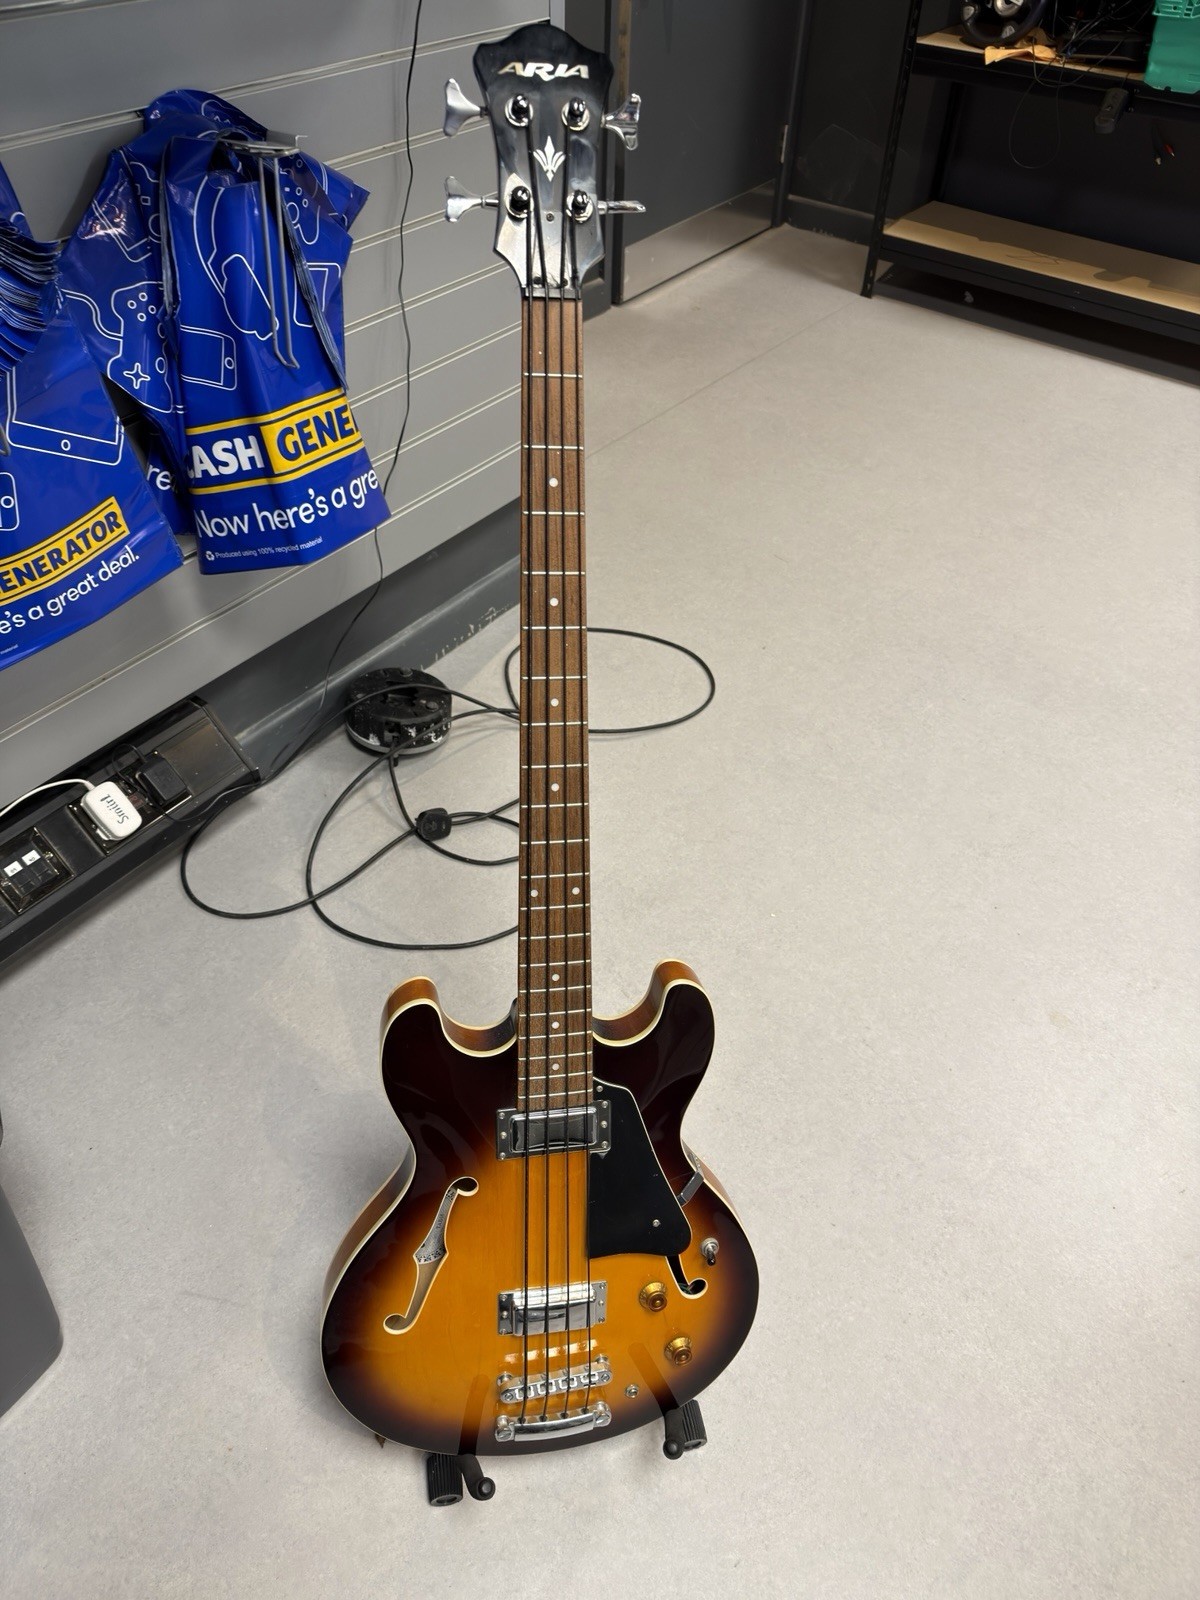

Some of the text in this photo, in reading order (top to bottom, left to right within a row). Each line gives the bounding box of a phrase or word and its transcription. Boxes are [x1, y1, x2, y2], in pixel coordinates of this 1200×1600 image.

[497, 62, 589, 81] ARIA
[277, 404, 359, 462] GENE
[194, 469, 379, 539] Now here's a gre
[215, 536, 323, 559] Produced using 100% recycled material
[28, 605, 45, 621] a
[47, 573, 99, 617] great
[98, 544, 140, 582] deal.
